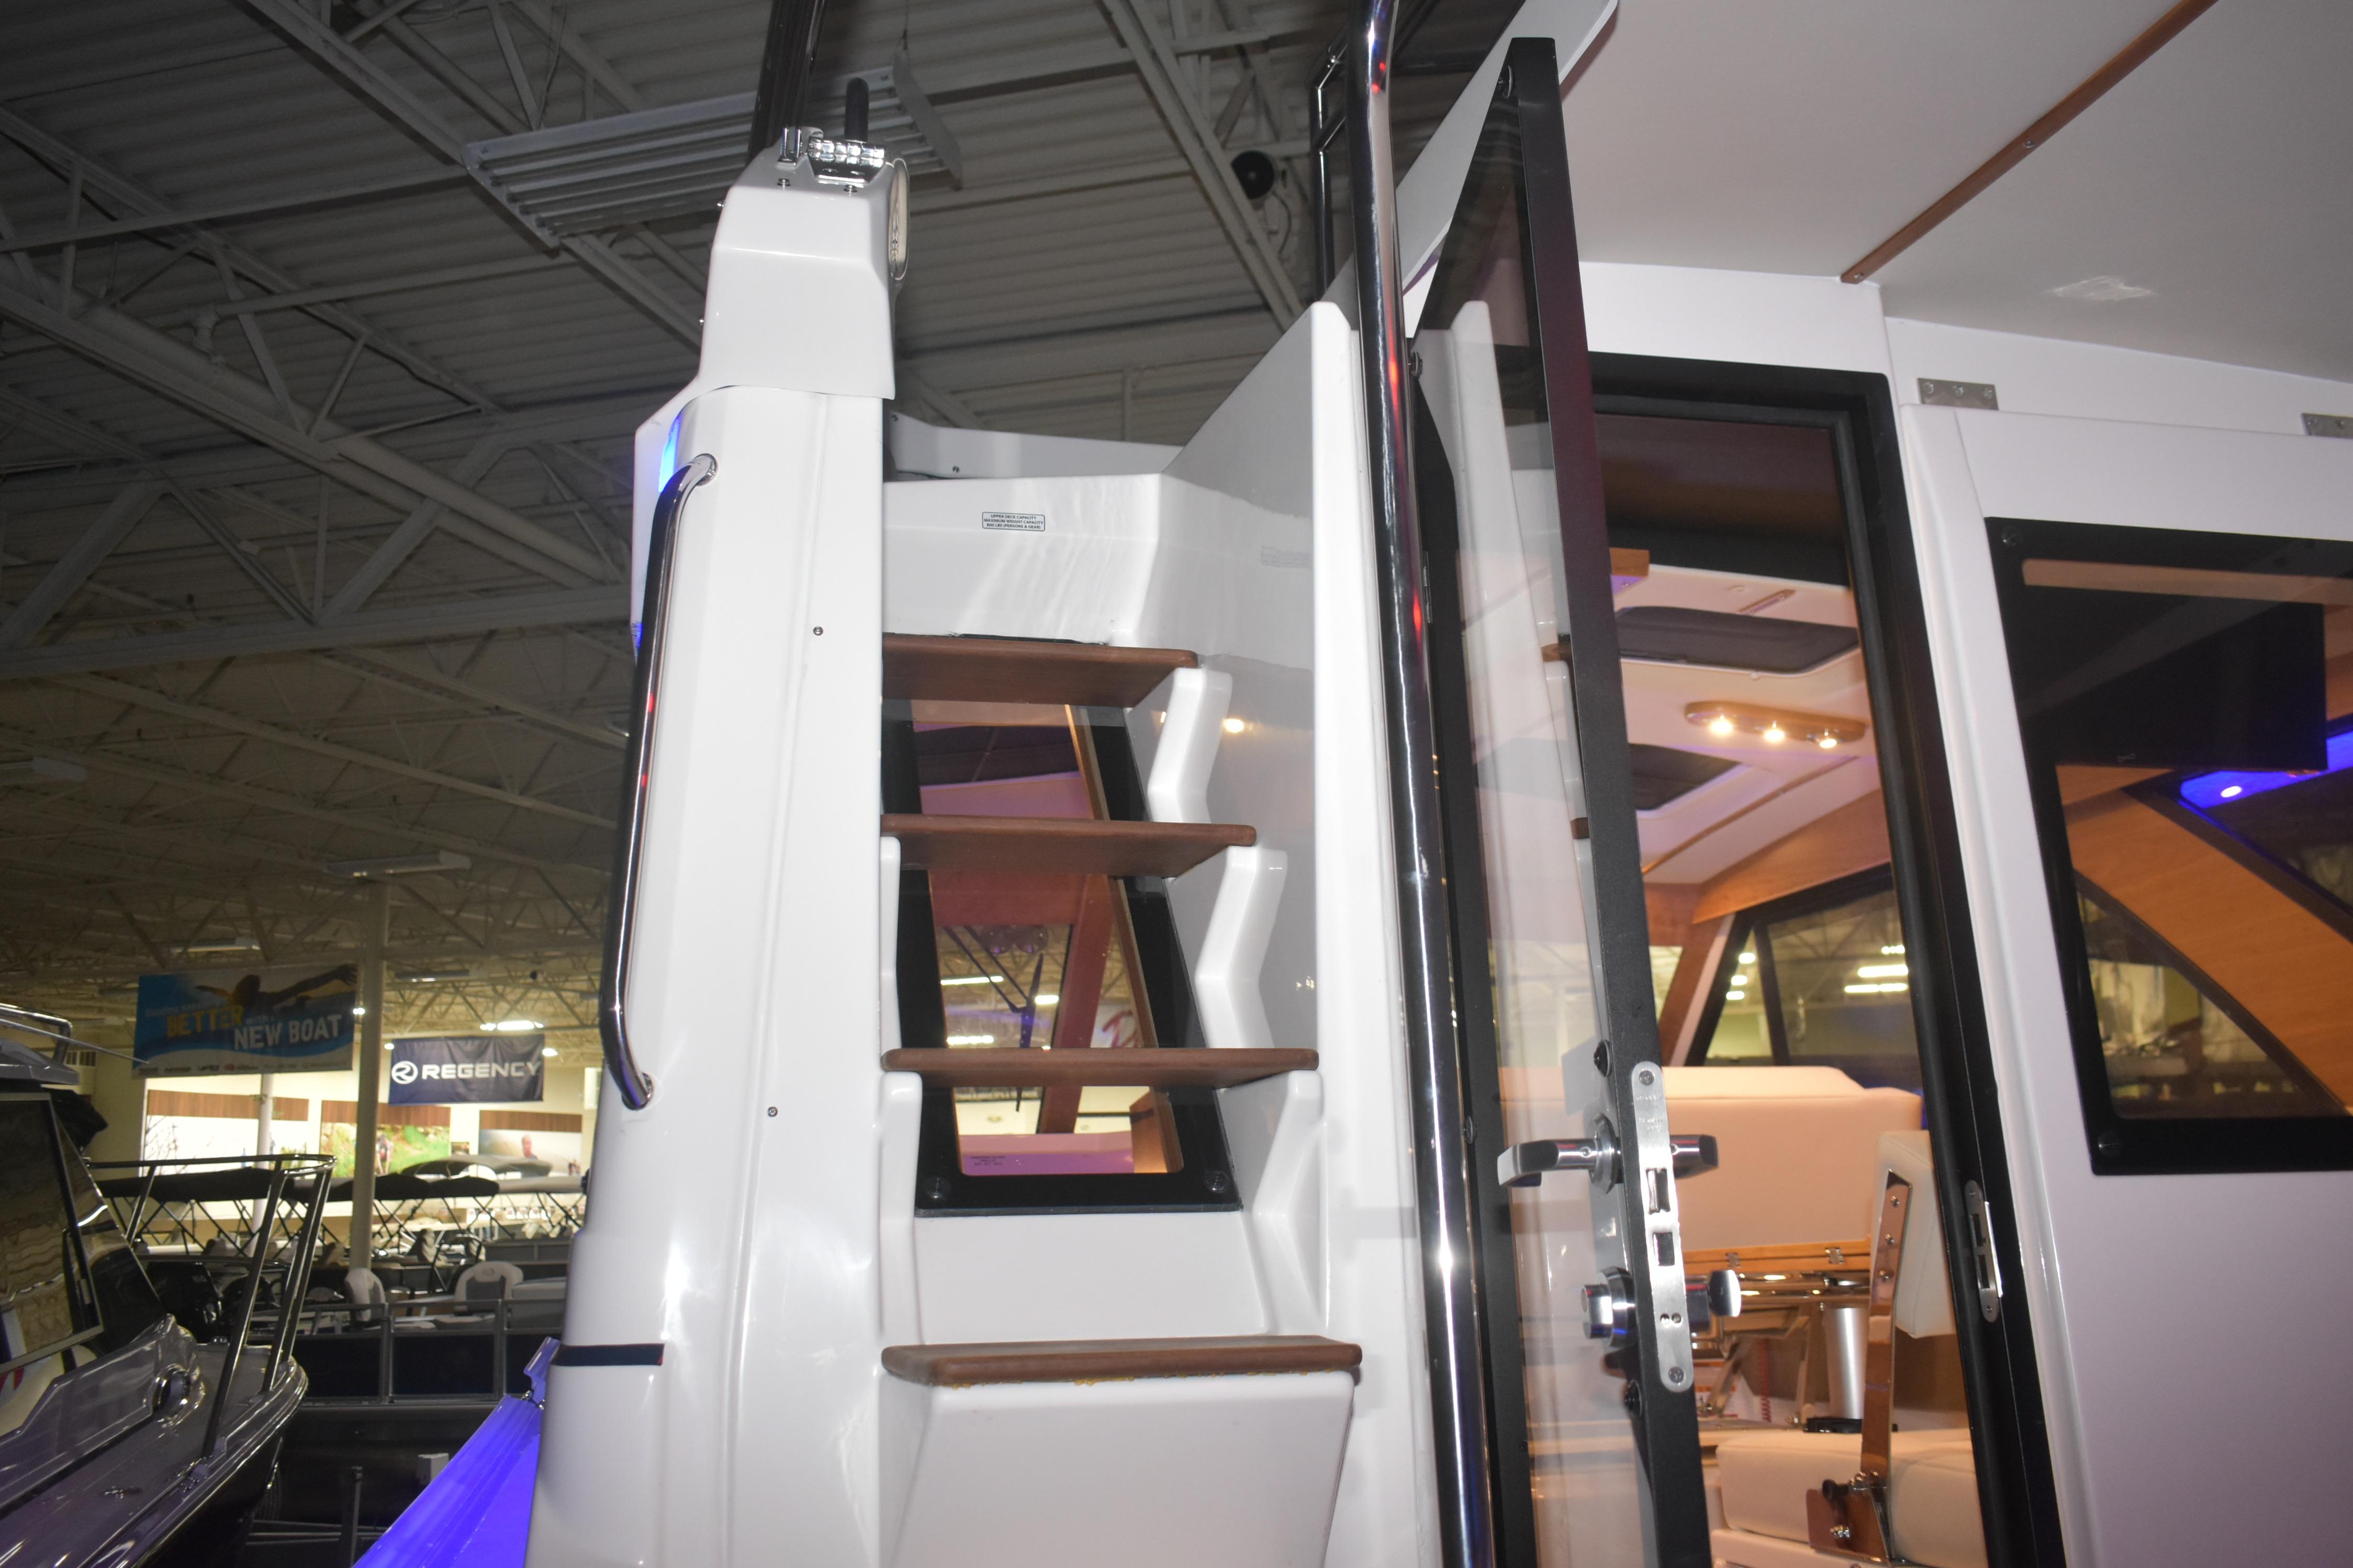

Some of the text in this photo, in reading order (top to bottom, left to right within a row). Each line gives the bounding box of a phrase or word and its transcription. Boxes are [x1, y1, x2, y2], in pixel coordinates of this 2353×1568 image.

[167, 1005, 244, 1038] BETTER
[234, 1014, 342, 1050] NEW BOAT
[422, 1061, 542, 1080] REGENCY
